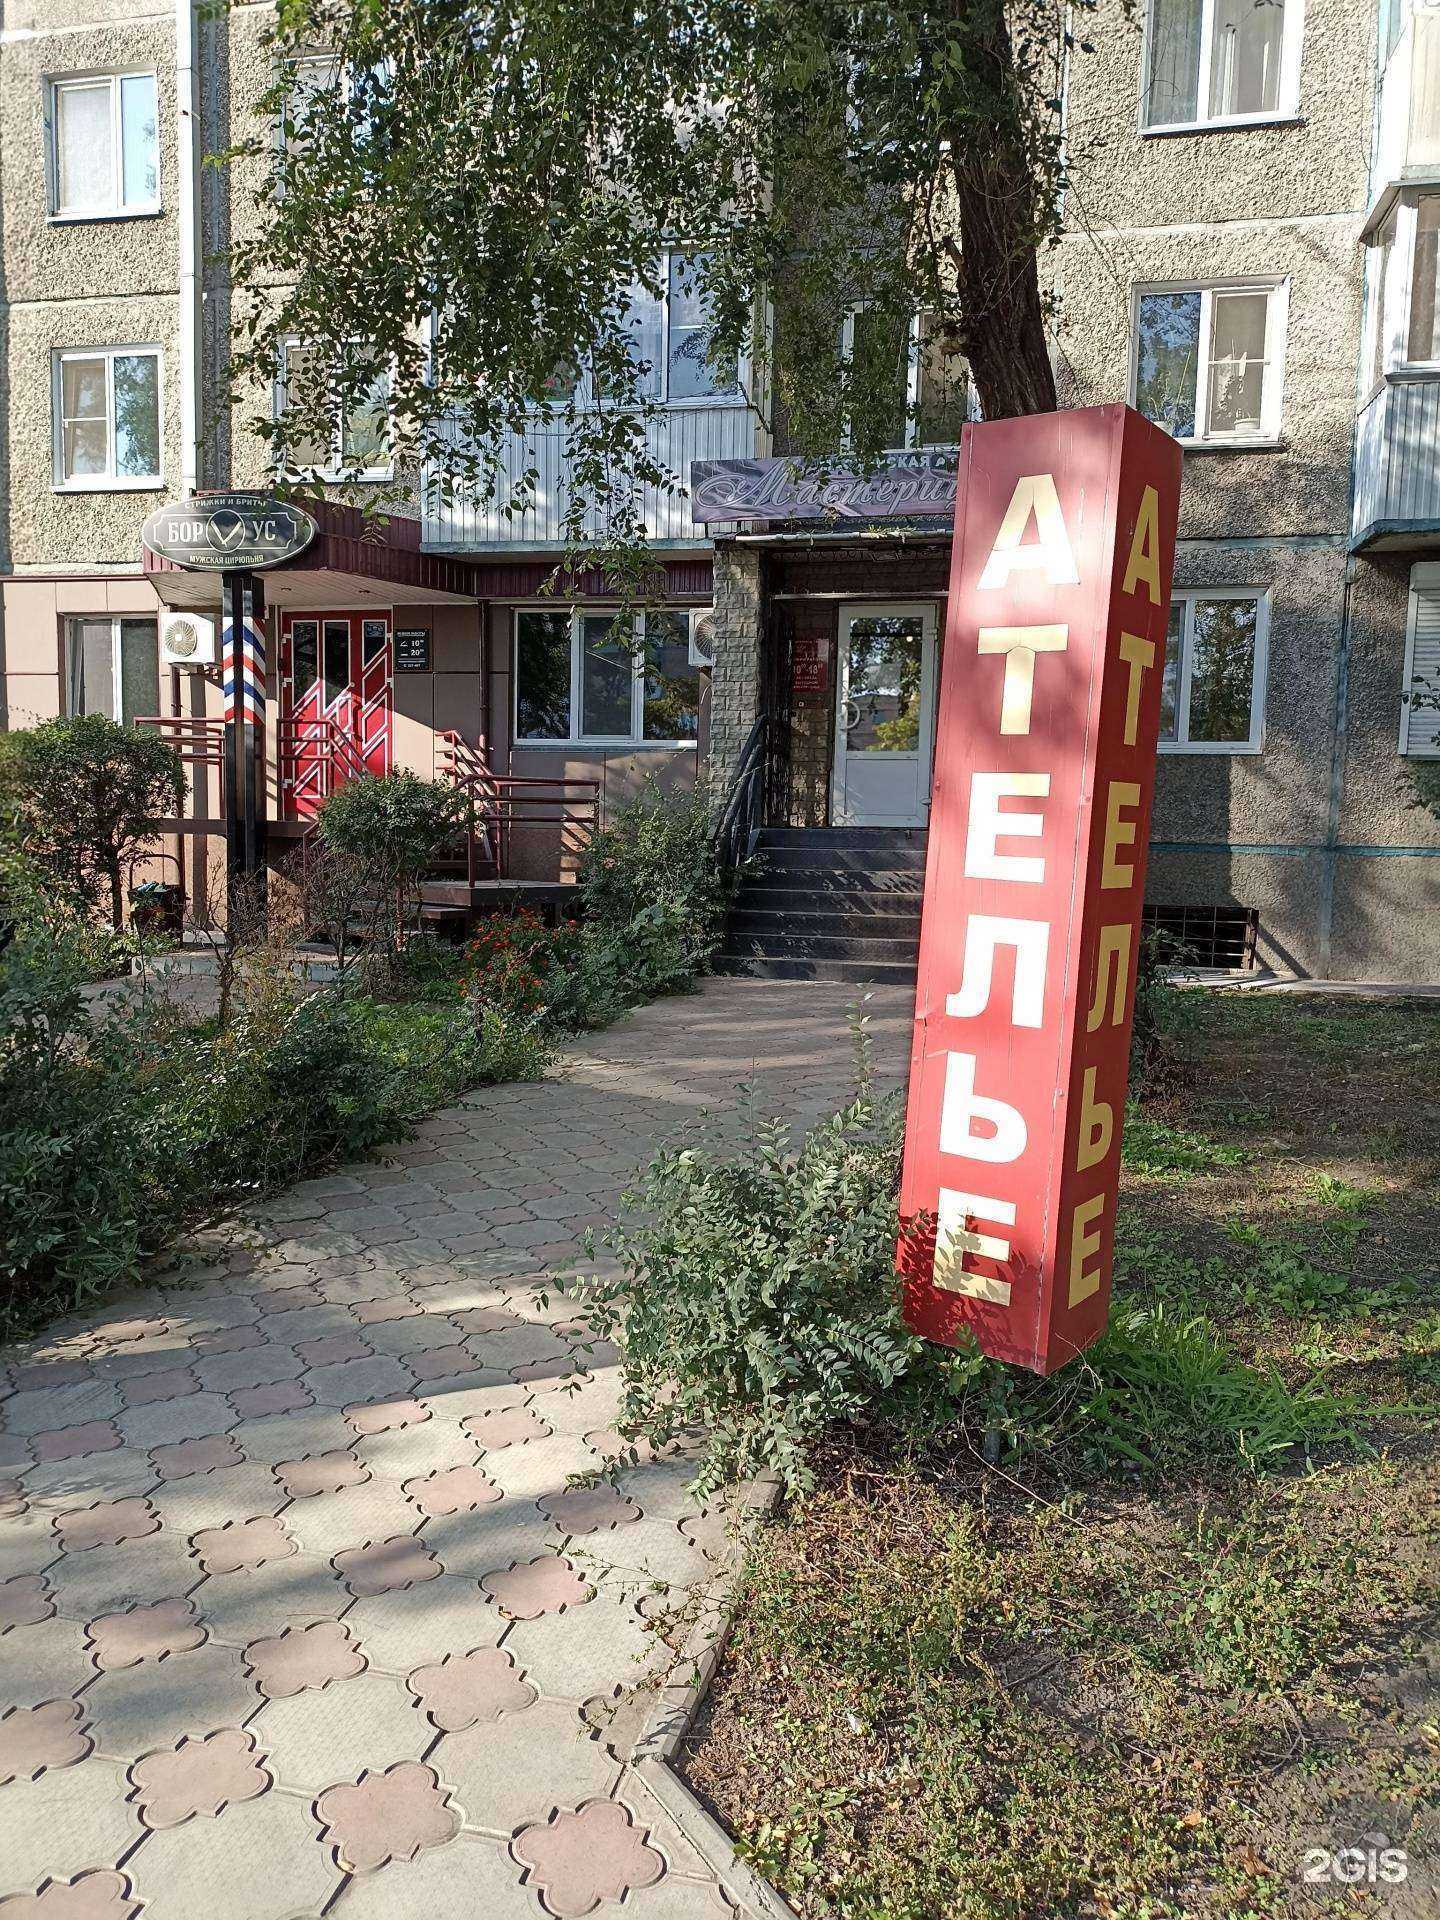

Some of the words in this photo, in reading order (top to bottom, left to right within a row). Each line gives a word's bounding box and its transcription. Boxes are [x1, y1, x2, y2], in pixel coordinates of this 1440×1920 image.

[184, 498, 226, 509] СТРИЖКИ
[189, 555, 224, 564] МУЖСКАЯ
[932, 474, 1080, 1307] АТЕЛЬЕ
[1068, 485, 1162, 1310] АТЕЛЬЕ
